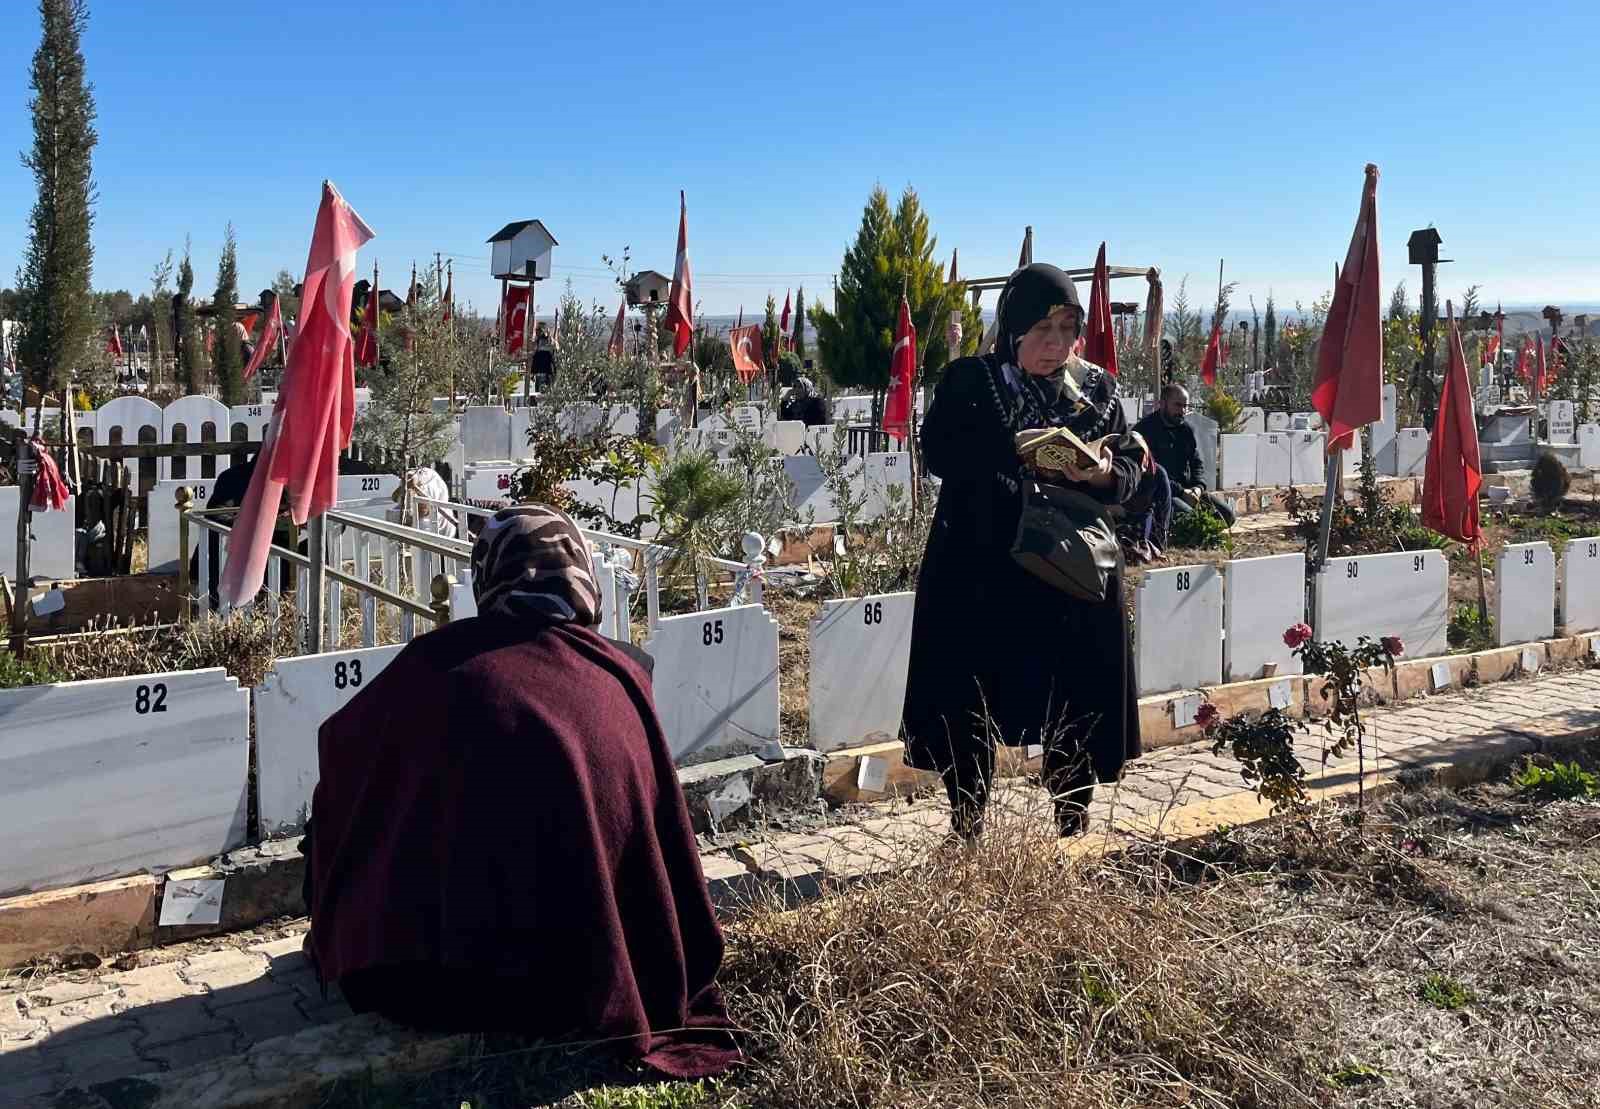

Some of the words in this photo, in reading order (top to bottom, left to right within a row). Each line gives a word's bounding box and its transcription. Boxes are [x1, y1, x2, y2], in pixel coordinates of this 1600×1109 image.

[885, 456, 897, 467] 227
[361, 478, 380, 491] 220
[1524, 549, 1534, 565] 92
[1588, 543, 1597, 558] 93
[1347, 561, 1358, 579] 90
[1414, 555, 1425, 572] 91
[1177, 572, 1191, 592] 88
[864, 602, 883, 626] 86
[702, 620, 724, 646] 85
[334, 659, 363, 690] 83
[136, 682, 168, 715] 82
